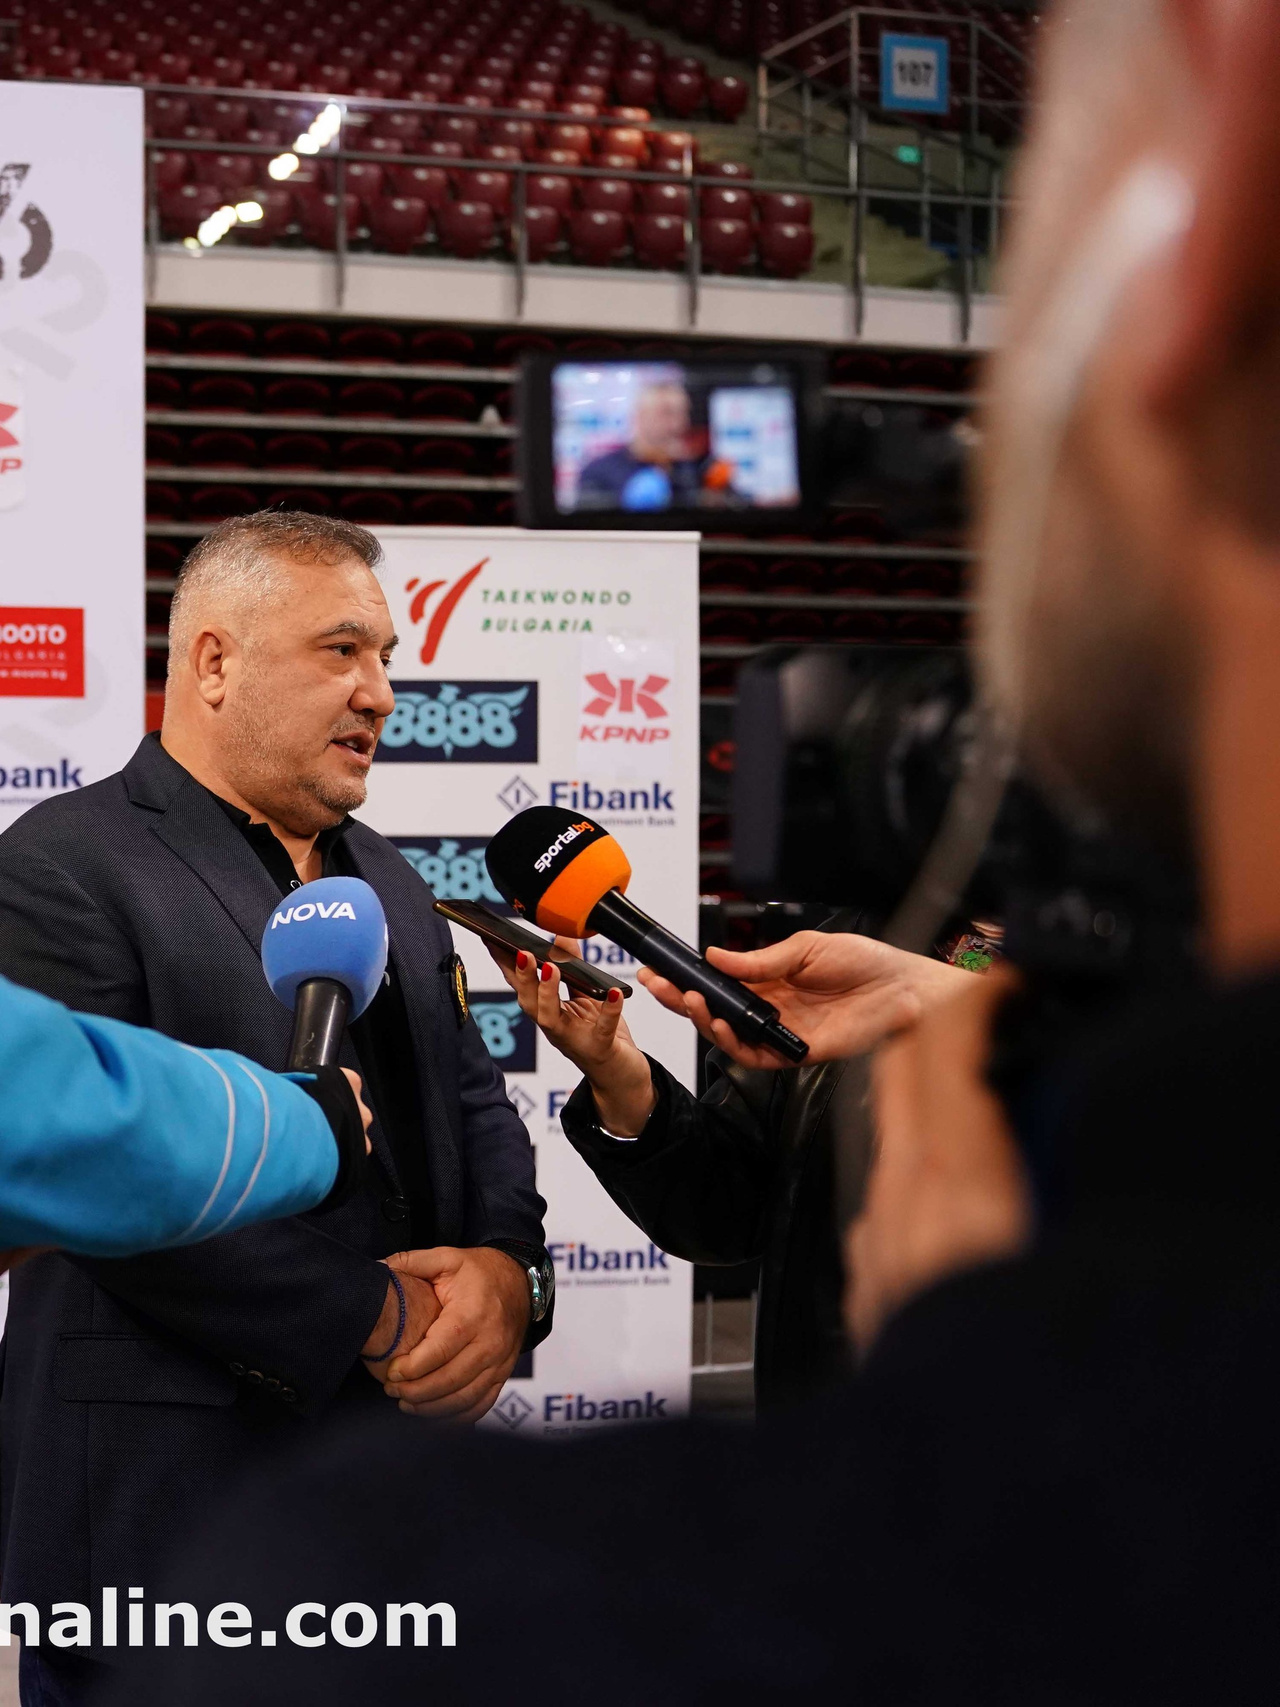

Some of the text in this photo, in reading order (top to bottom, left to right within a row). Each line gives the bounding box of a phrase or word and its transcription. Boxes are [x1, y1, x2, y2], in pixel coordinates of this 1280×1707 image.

[481, 589, 633, 606] TAEKWONDO
[481, 617, 595, 634] BULGARIA
[580, 726, 671, 744] KPNP
[550, 781, 674, 811] Fibank
[270, 901, 357, 930] NOVA
[548, 1242, 668, 1271] Fibank
[544, 1390, 668, 1421] Fibank
